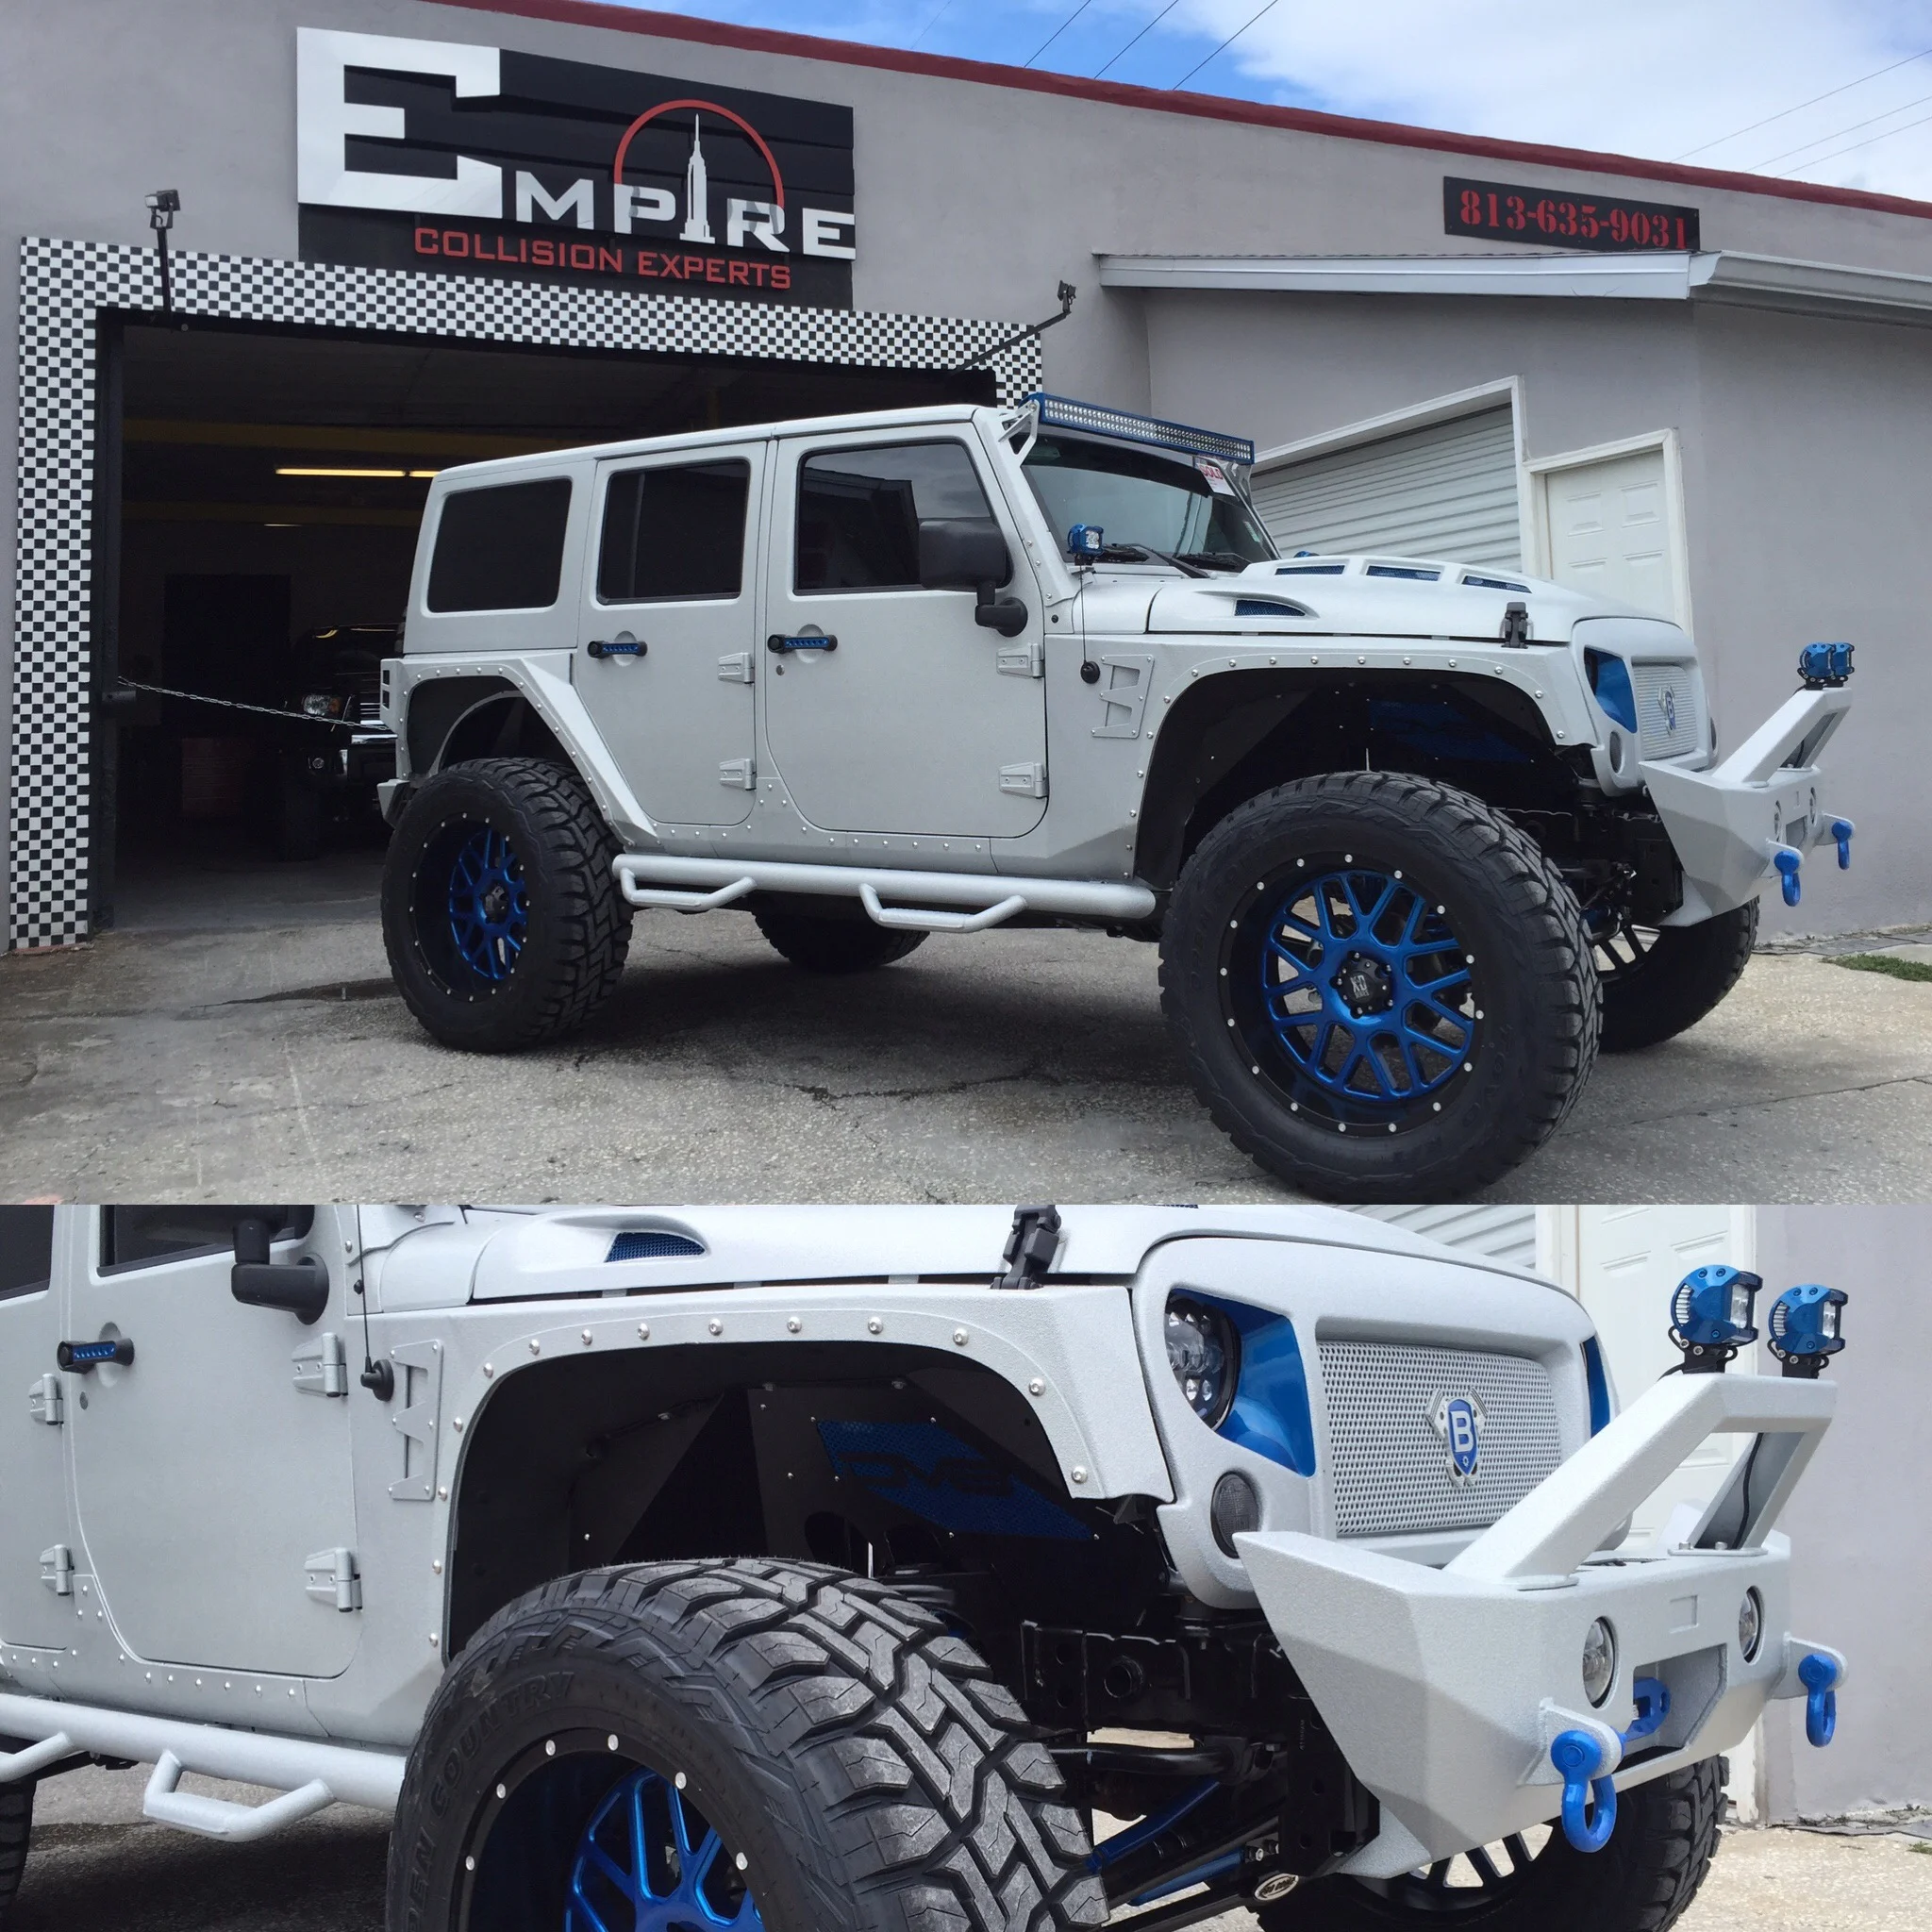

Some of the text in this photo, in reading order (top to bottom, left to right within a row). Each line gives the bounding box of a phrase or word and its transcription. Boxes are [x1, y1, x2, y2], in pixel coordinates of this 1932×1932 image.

[296, 26, 857, 260] EMPIRE
[1460, 190, 1688, 249] 813-635-9031
[415, 226, 791, 290] COLLISION EXPERTS
[1450, 1410, 1474, 1453] B
[430, 1671, 575, 1820] COUNTRY
